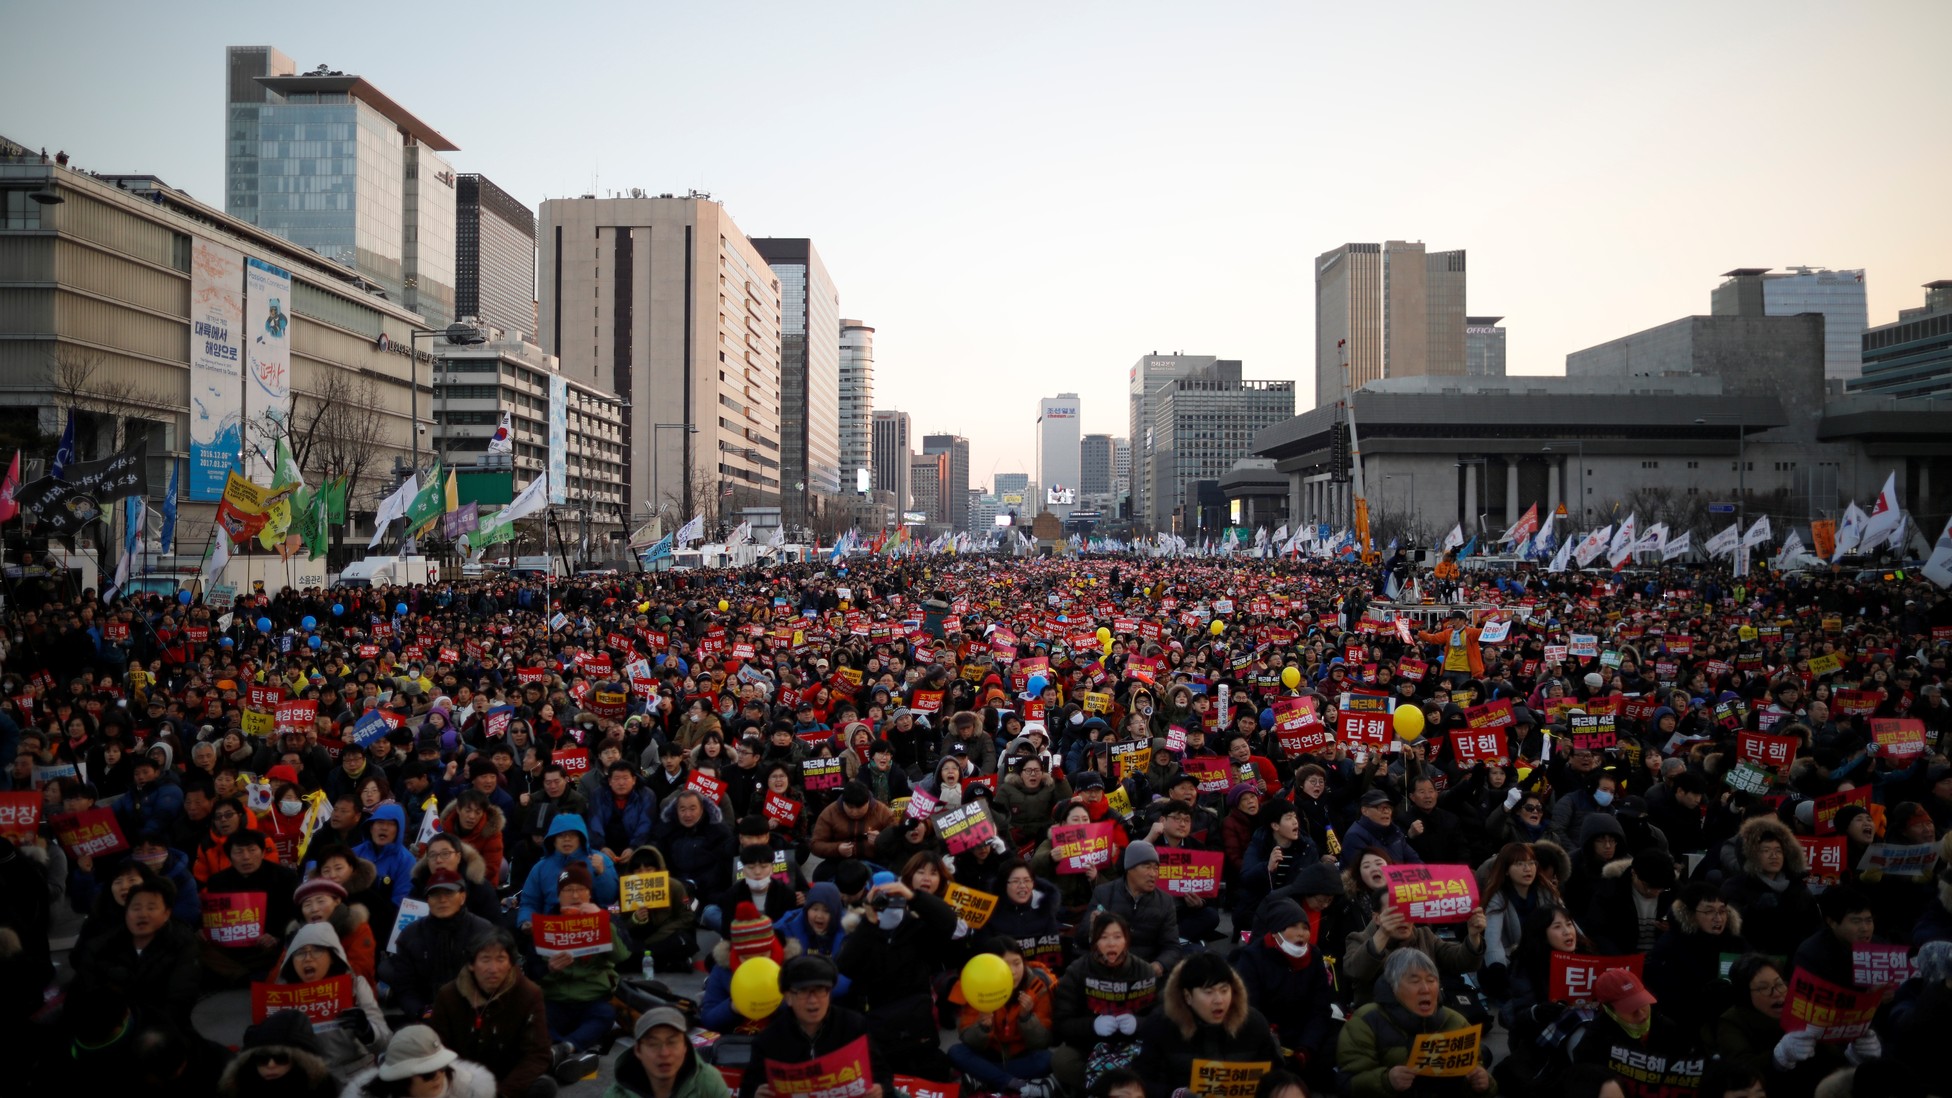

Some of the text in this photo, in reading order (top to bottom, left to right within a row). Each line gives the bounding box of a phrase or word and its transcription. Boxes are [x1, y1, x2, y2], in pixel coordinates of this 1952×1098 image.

[195, 321, 228, 342] 대륙에서
[205, 341, 238, 361] 해양으로
[299, 576, 323, 584] 소음관리
[427, 566, 437, 585] kt
[1181, 615, 1195, 625] 탄핵
[108, 626, 126, 636] 탄핵
[611, 637, 629, 648] 탄핵
[648, 634, 665, 646] 탄핵
[705, 640, 722, 649] 탄핵
[251, 690, 279, 704] 탄핵
[1350, 699, 1377, 709] 박근혜
[275, 709, 315, 722] 특검연장
[1275, 706, 1309, 724] 퇴진·구속!
[1572, 714, 1614, 726] 박근혜 4년
[1346, 718, 1385, 741] 탄핵
[1876, 731, 1921, 744] 퇴진·구속!
[1111, 743, 1136, 755] 박근혜
[1279, 733, 1323, 749] 특검연장
[1457, 733, 1498, 756] 탄핵
[1573, 733, 1617, 749] 끝났다
[1745, 739, 1787, 762] 탄핵
[551, 757, 587, 770] 검연장
[803, 757, 840, 768] 박근혜 4년
[696, 775, 719, 790] 박근혜
[804, 774, 843, 791] 끝났다
[772, 796, 793, 810] 박근혜
[936, 803, 982, 829] 박근혜 4년
[945, 823, 994, 854] 끝났다
[1055, 829, 1086, 843] 박근혜
[1060, 836, 1109, 859] 퇴진·구속!
[1159, 852, 1192, 865] 박근혜
[1158, 865, 1215, 880] 퇴진·구속!
[1389, 868, 1432, 882] 박근혜
[624, 876, 665, 890] 박근혜를
[1168, 879, 1214, 893] 특검연장
[1394, 879, 1469, 903] 퇴진·구속!
[625, 888, 665, 903] 구속하라
[952, 890, 993, 909] 박근혜를
[1410, 895, 1472, 918] 특검연장
[544, 916, 599, 932] 조기탄핵!
[211, 923, 260, 942] 특검연장
[544, 931, 600, 946] 특검연장!
[1853, 951, 1908, 969] 박근혜
[266, 981, 339, 1004] 조기탄핵!
[1086, 977, 1156, 993] 박근혜 4년
[1795, 979, 1856, 1009] 박근혜
[1420, 1032, 1476, 1053] 박근혜를
[1415, 1051, 1474, 1069] 구속하라
[1610, 1045, 1704, 1076] 박근혜 4년
[773, 1059, 863, 1094] 퇴진·구속!
